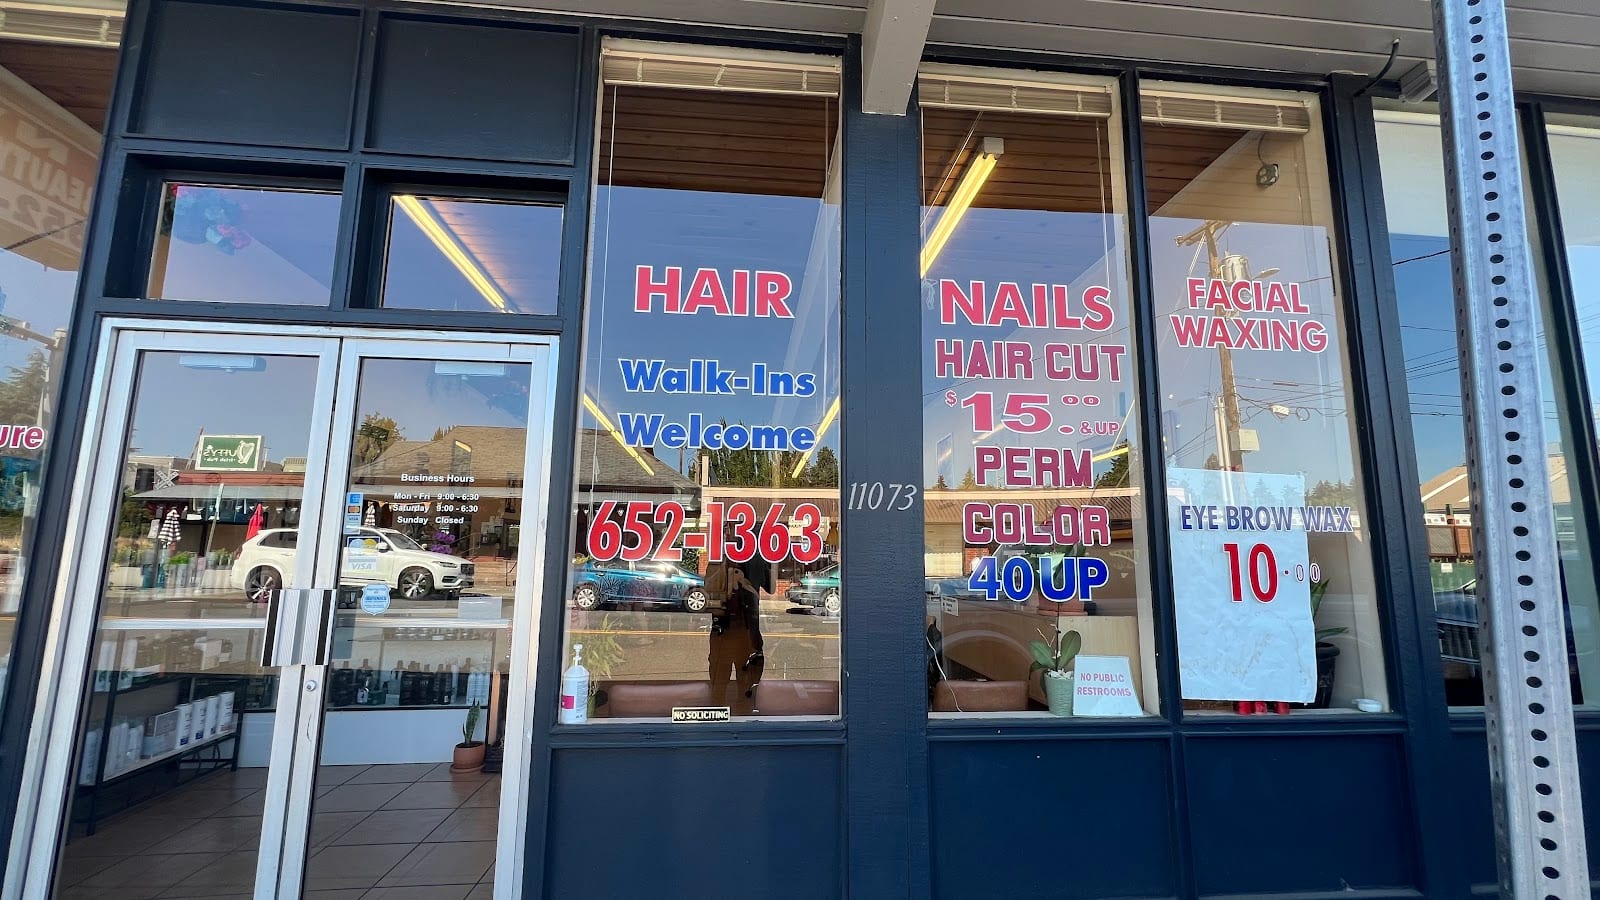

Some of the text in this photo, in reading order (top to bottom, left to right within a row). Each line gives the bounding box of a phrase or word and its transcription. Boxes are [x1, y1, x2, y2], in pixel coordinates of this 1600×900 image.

[634, 265, 795, 319] HAIR
[940, 279, 1115, 331] NAILS
[1187, 277, 1310, 314] FACIAL
[1169, 314, 1328, 353] WAXING
[935, 339, 1126, 382] HAIR CUT
[618, 358, 816, 397] Walk-Ins
[617, 412, 816, 452] Welcome
[401, 473, 475, 483] Business Hours
[974, 446, 1094, 489] PERM
[393, 492, 412, 500] Mon
[419, 492, 431, 500] Fri
[461, 493, 479, 501] 6:30
[393, 504, 430, 513] Saturday
[848, 481, 918, 511] 11073
[397, 515, 465, 525] Sunday Closed
[587, 500, 823, 564] 652-1363
[963, 503, 1111, 547] COLOR
[1180, 505, 1354, 533] EYE BROW WAX
[351, 562, 372, 570] VISA
[1077, 686, 1132, 697] RESTROOMS
[1080, 672, 1125, 683] NO PUBLIC
[674, 710, 729, 720] NO SOLICITING
